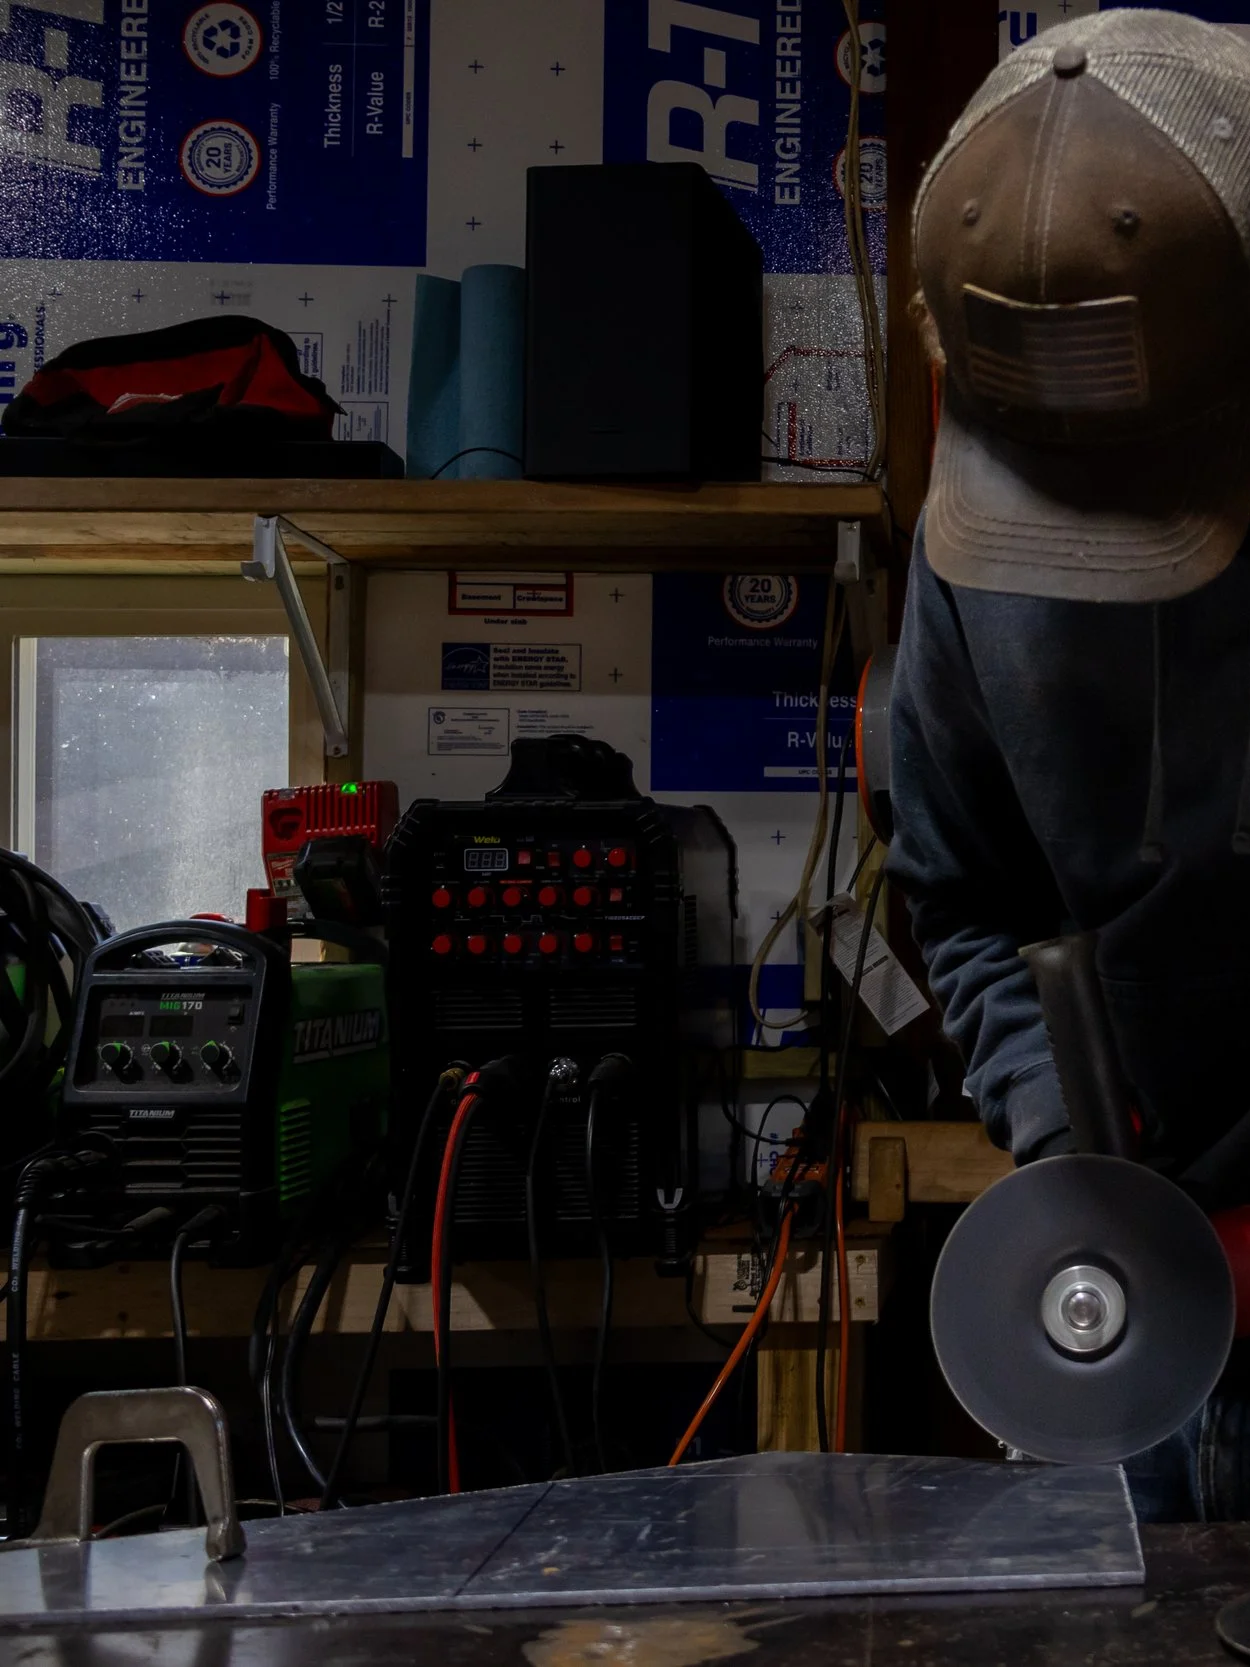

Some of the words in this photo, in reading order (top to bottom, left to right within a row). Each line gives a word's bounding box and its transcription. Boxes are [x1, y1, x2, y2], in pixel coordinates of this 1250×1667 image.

[268, 0, 282, 53] Recyclable
[116, 0, 148, 191] ENGINEERE
[323, 63, 343, 149] Thickness
[366, 71, 386, 136] R-Value
[267, 102, 282, 146] Warranty
[205, 146, 222, 169] 20
[222, 142, 233, 174] YEARS
[858, 162, 874, 185] 20
[265, 148, 279, 211] Performance
[743, 594, 777, 604] YEARS
[749, 577, 772, 593] 20
[707, 635, 771, 648] Performance
[773, 636, 819, 651] Warranty
[772, 690, 858, 709] Thickess
[787, 731, 854, 749] R-Vlu
[293, 1010, 381, 1054] TITANIUM
[128, 1109, 176, 1119] TITANIUM
[11, 1230, 22, 1271] WELDING
